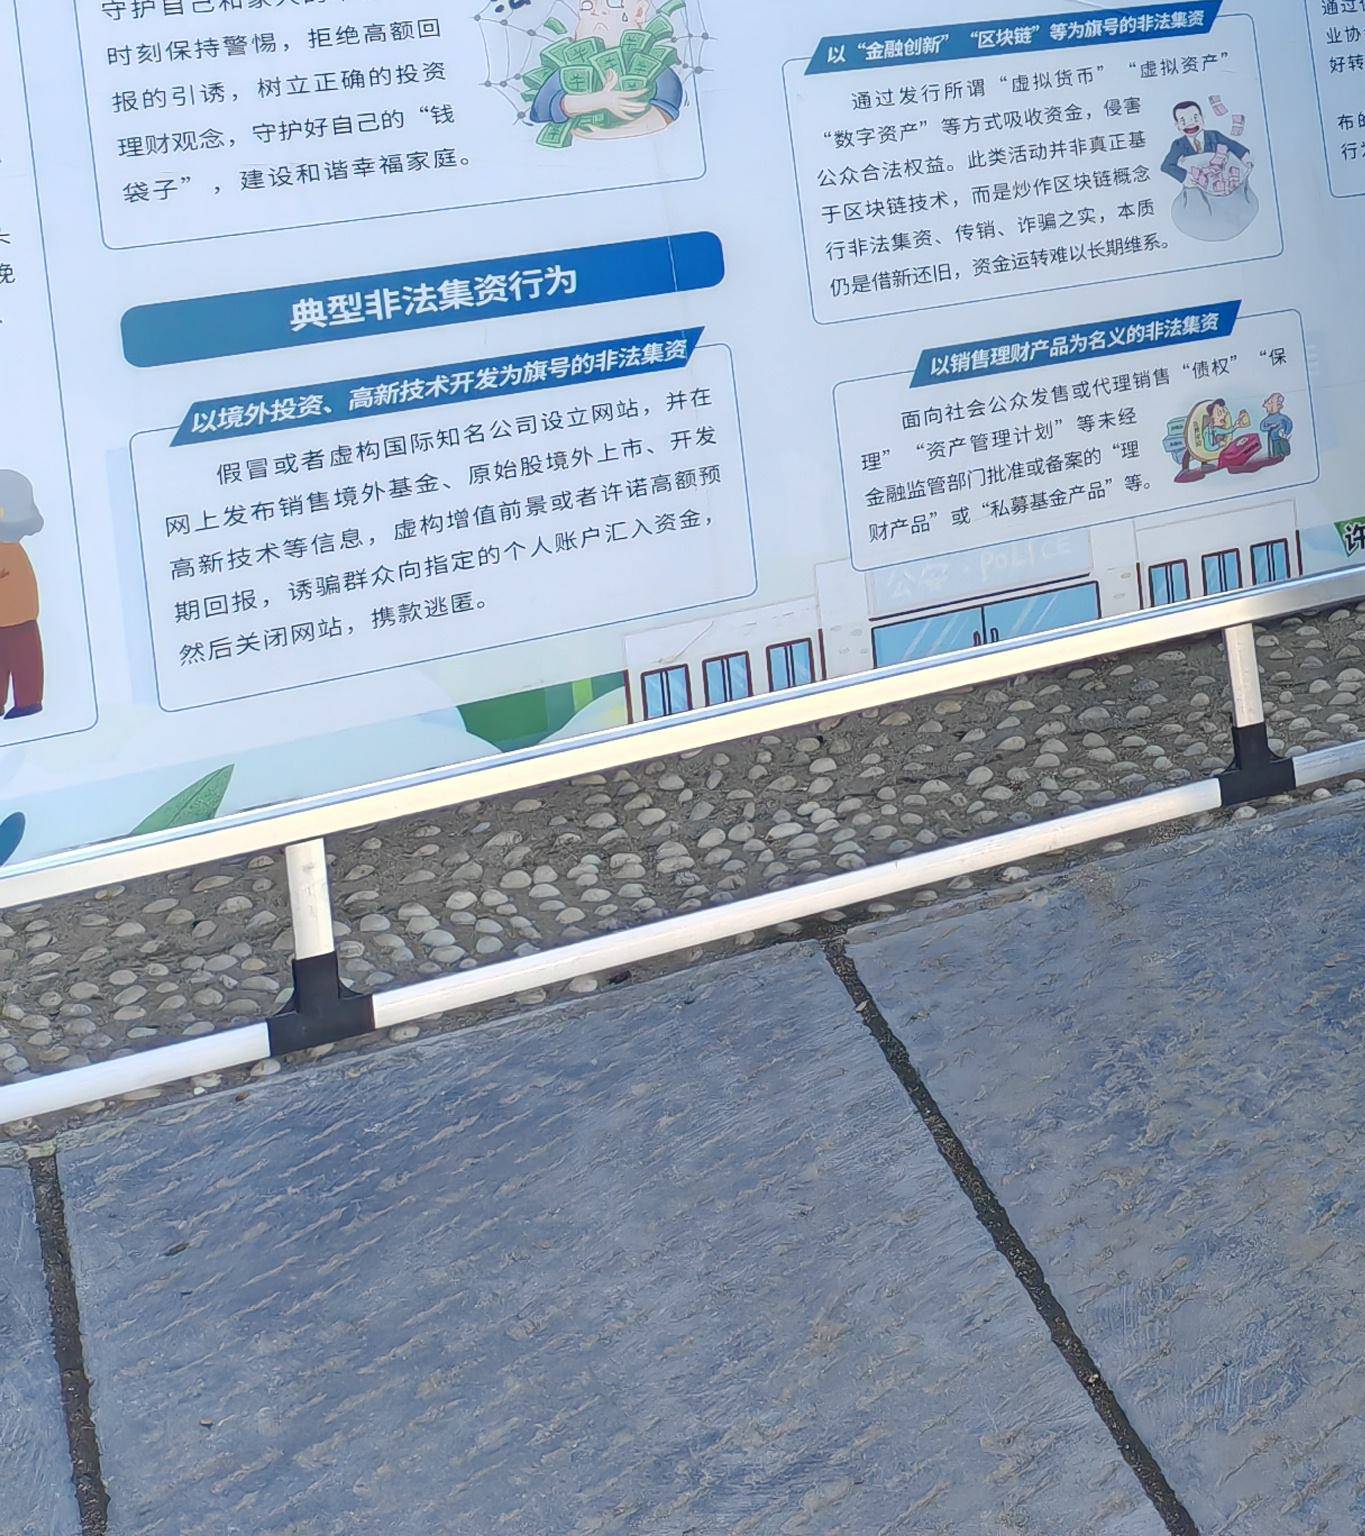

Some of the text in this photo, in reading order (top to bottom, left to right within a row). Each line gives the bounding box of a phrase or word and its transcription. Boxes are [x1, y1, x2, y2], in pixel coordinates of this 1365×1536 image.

[107, 18, 441, 66] 时刻保持警惕，拒绝高额回
[112, 62, 447, 112] 报的引诱，树立正确的投资
[117, 104, 454, 158] 理财观念，守护好自己的“钱
[818, 129, 1146, 188] 公众合法权益。此类活动并非真正基
[123, 149, 470, 204] 袋子”，建设和谐幸福家庭。
[821, 165, 1151, 225] 于区块链技术，而是炒作区块链概念
[825, 198, 1155, 262] 行非法集资、传销、诈骗之实，本质
[830, 231, 1168, 298] 仍是借新还旧，资金运转难以长期维系。
[290, 264, 578, 334] 典型非法集资行为
[930, 312, 1219, 376] 以销售理财产品为名义的非法集资
[191, 339, 688, 435] 以境外投资、高新技术开发为旗号的非法集资
[216, 387, 712, 486] 假冒或者虚构国际知名公司设立网站，并在
[165, 425, 718, 537] 网上发布销售境外基金、原始股境外上市、开发
[865, 440, 1140, 508] 金融监管部门批准或备案的“理
[170, 463, 722, 580] 高新技术等信息，虚构增值前景或者许诺高额预
[174, 508, 715, 624] 期回报，诱骗群众向指定的个人账户汇入资金，
[179, 590, 488, 667] 然后关闭网站，携款逃匿。
